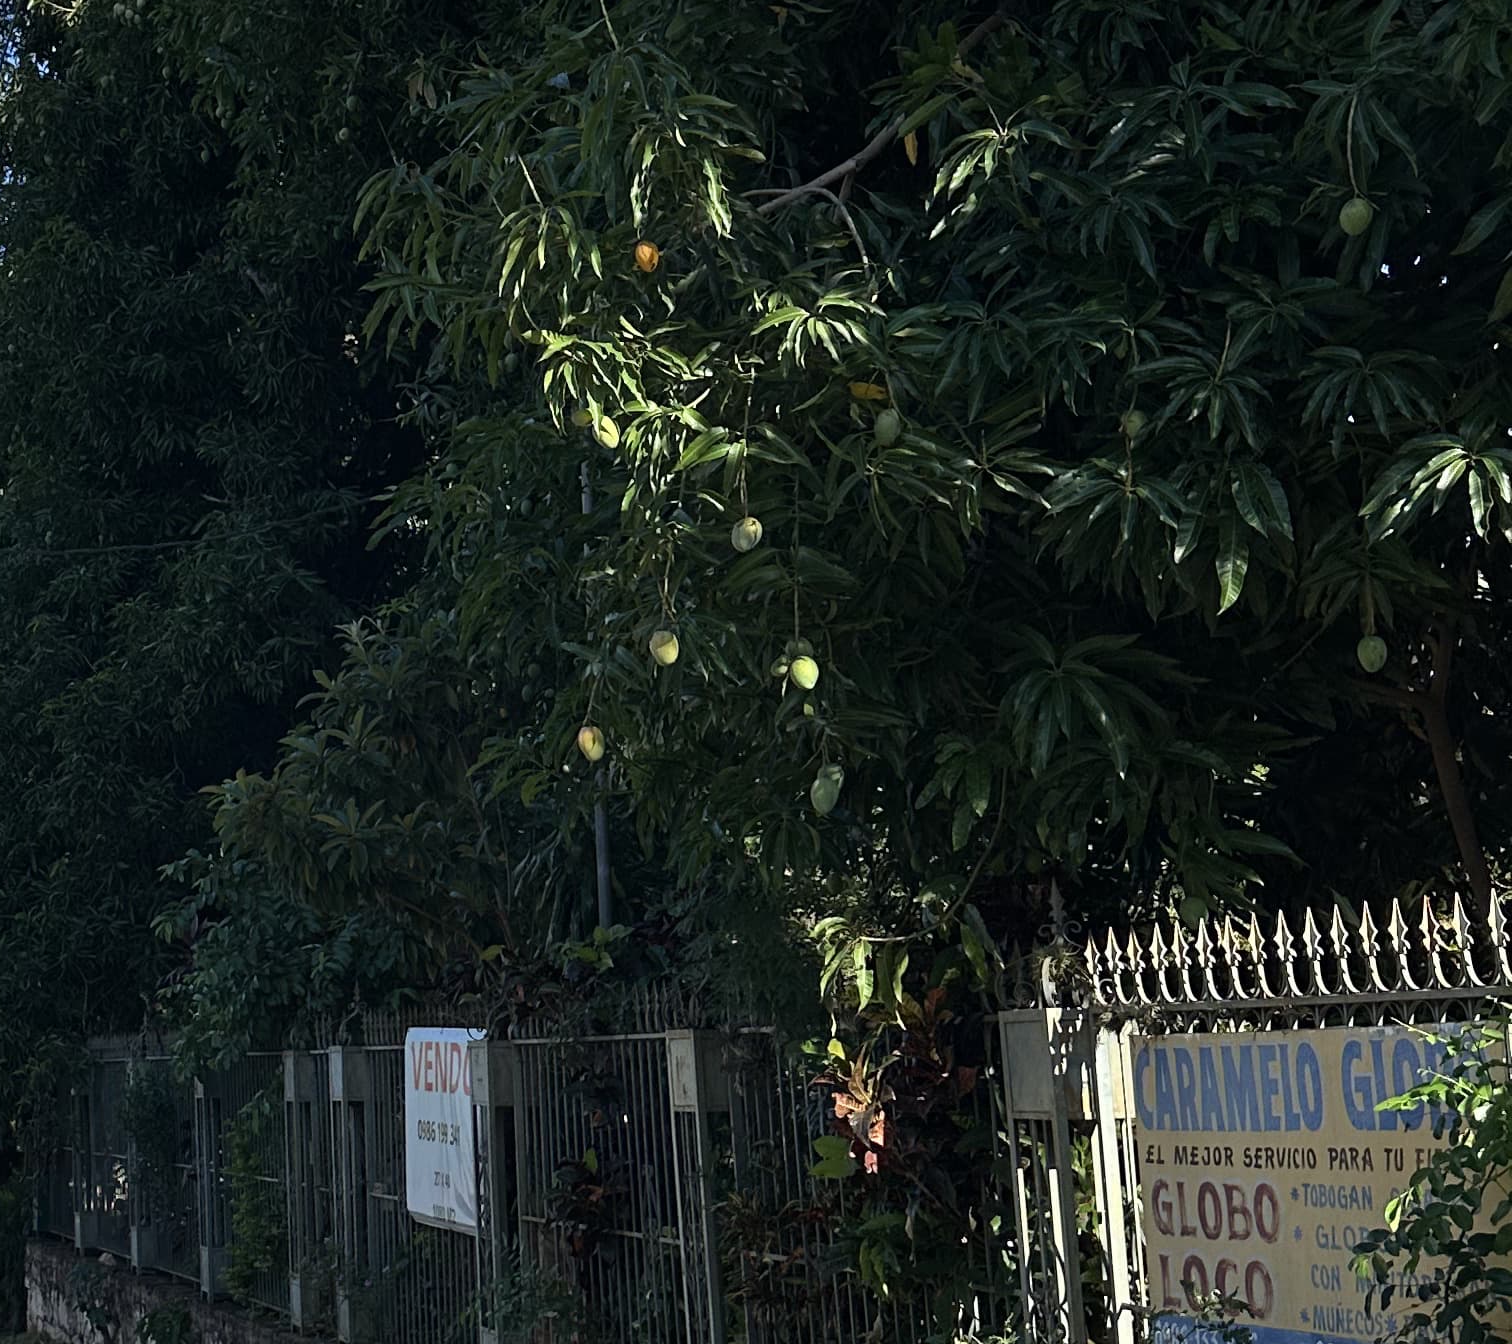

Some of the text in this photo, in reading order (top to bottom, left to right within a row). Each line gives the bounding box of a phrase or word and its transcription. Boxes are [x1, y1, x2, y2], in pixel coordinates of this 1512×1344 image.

[1135, 1042, 1324, 1132] CARAMELO
[1145, 1145, 1165, 1165] EL
[1174, 1145, 1234, 1167] MEJOR
[1243, 1147, 1317, 1170] SERVICIO
[1328, 1147, 1374, 1172] PARA
[1384, 1147, 1404, 1172] TU
[1152, 1179, 1281, 1244] GLOBO
[1301, 1183, 1374, 1212] TOBOGAN
[1158, 1254, 1274, 1320] LOCO
[1311, 1263, 1342, 1293] CON
